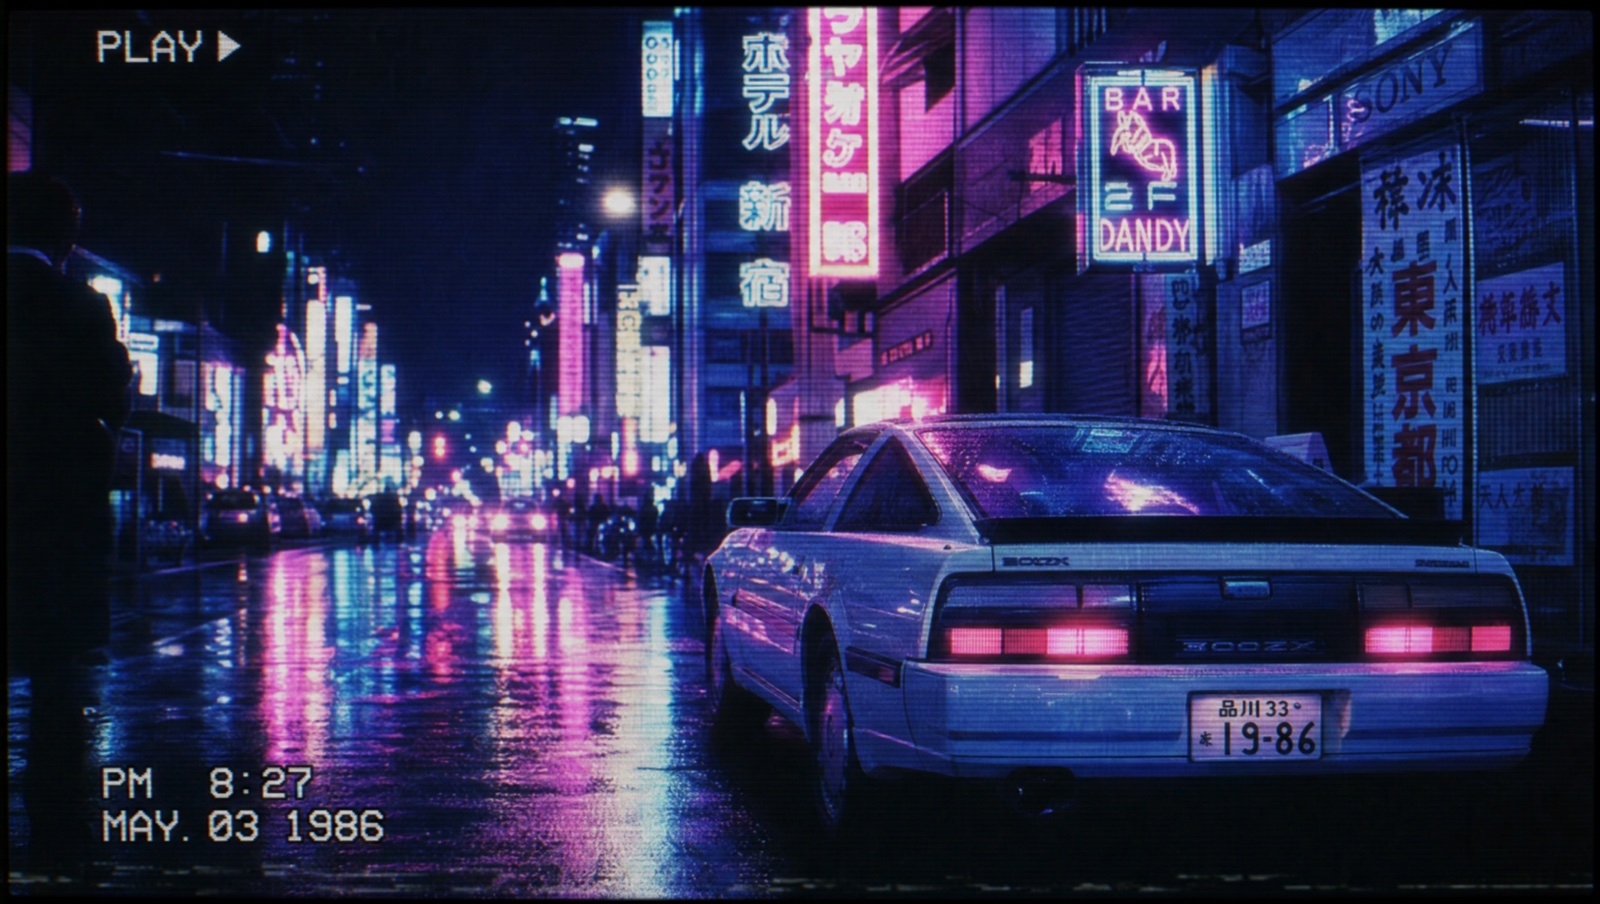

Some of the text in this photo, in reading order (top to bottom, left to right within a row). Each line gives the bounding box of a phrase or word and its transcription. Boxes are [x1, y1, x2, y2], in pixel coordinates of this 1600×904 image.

[1104, 86, 1181, 111] BAR
[1353, 43, 1453, 124] SONY
[1100, 218, 1190, 253] DANDY
[1389, 260, 1437, 487] 東京都
[1219, 699, 1289, 718] 品川 33
[1223, 721, 1316, 757] 19-86
